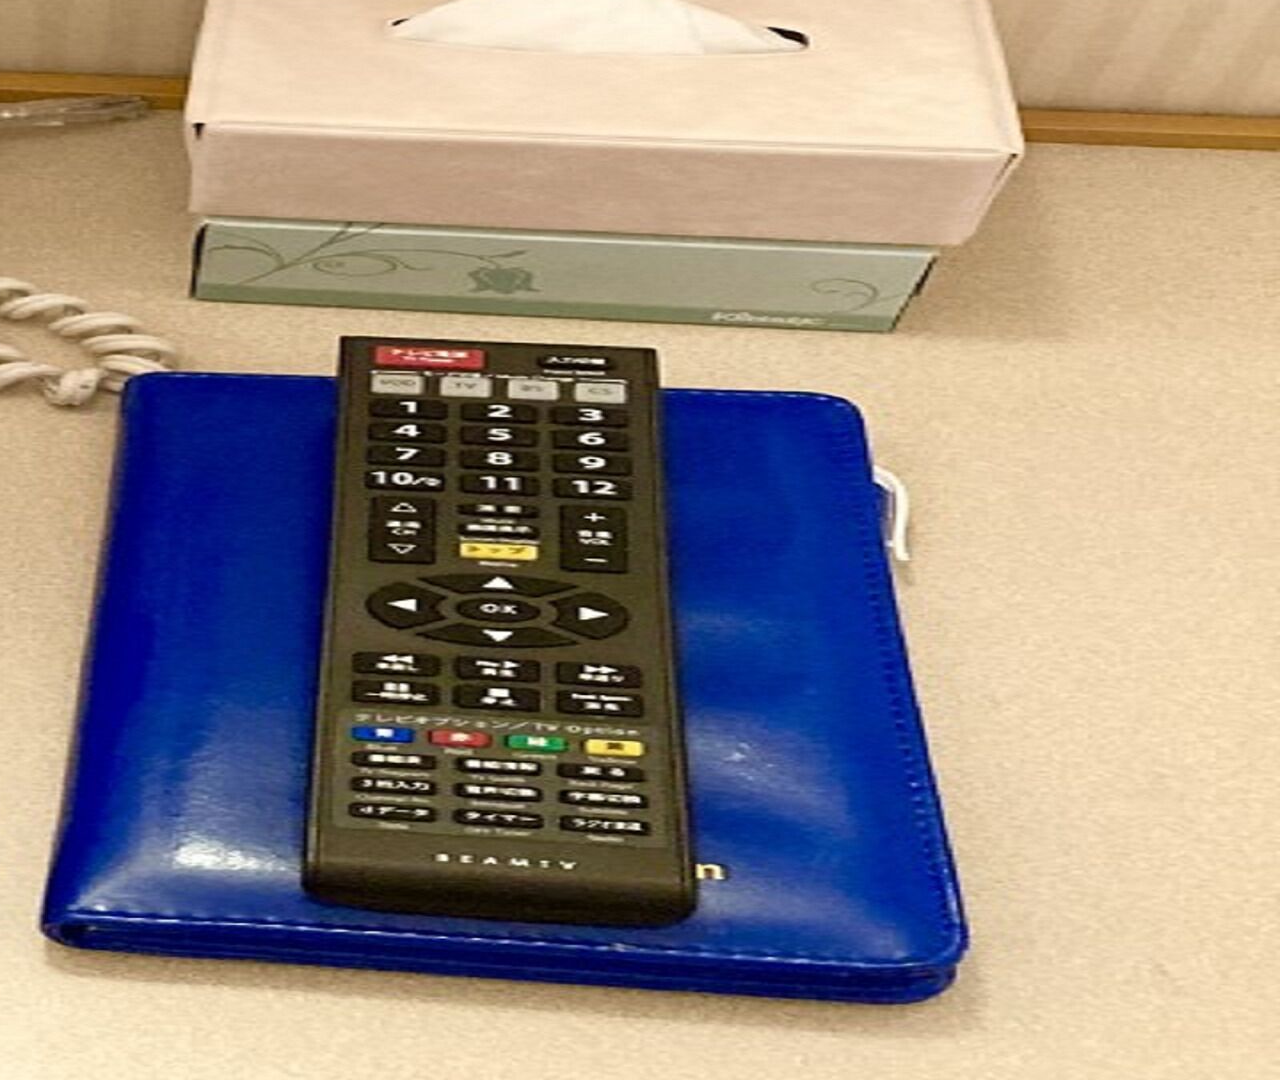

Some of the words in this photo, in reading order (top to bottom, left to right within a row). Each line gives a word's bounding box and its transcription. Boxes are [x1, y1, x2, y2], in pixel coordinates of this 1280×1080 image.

[399, 401, 418, 414] 1
[486, 404, 513, 418] 2
[577, 408, 605, 422] 3
[392, 424, 421, 437] 4
[487, 428, 513, 441] 5
[577, 432, 606, 446] 6
[394, 447, 421, 460] 7
[486, 451, 513, 465] 8
[577, 456, 606, 469] 9
[479, 476, 521, 491] 11
[571, 480, 618, 495] 12
[479, 603, 518, 616] OK
